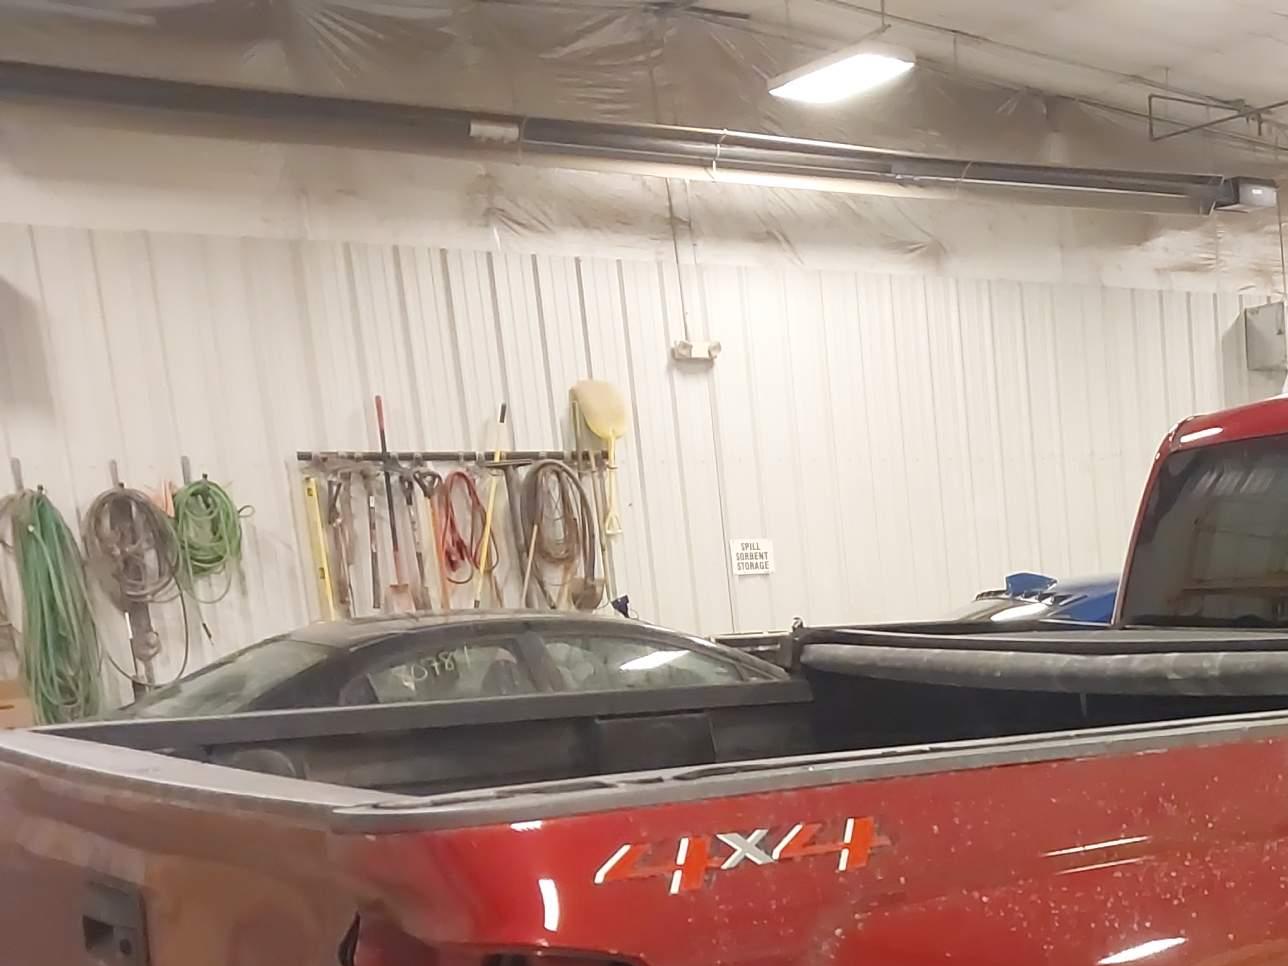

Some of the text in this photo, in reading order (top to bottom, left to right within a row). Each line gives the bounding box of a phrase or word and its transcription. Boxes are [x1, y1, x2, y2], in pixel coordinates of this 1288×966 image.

[740, 541, 761, 551] SPILL
[735, 551, 770, 561] SORBENT
[737, 560, 770, 571] STORAGE
